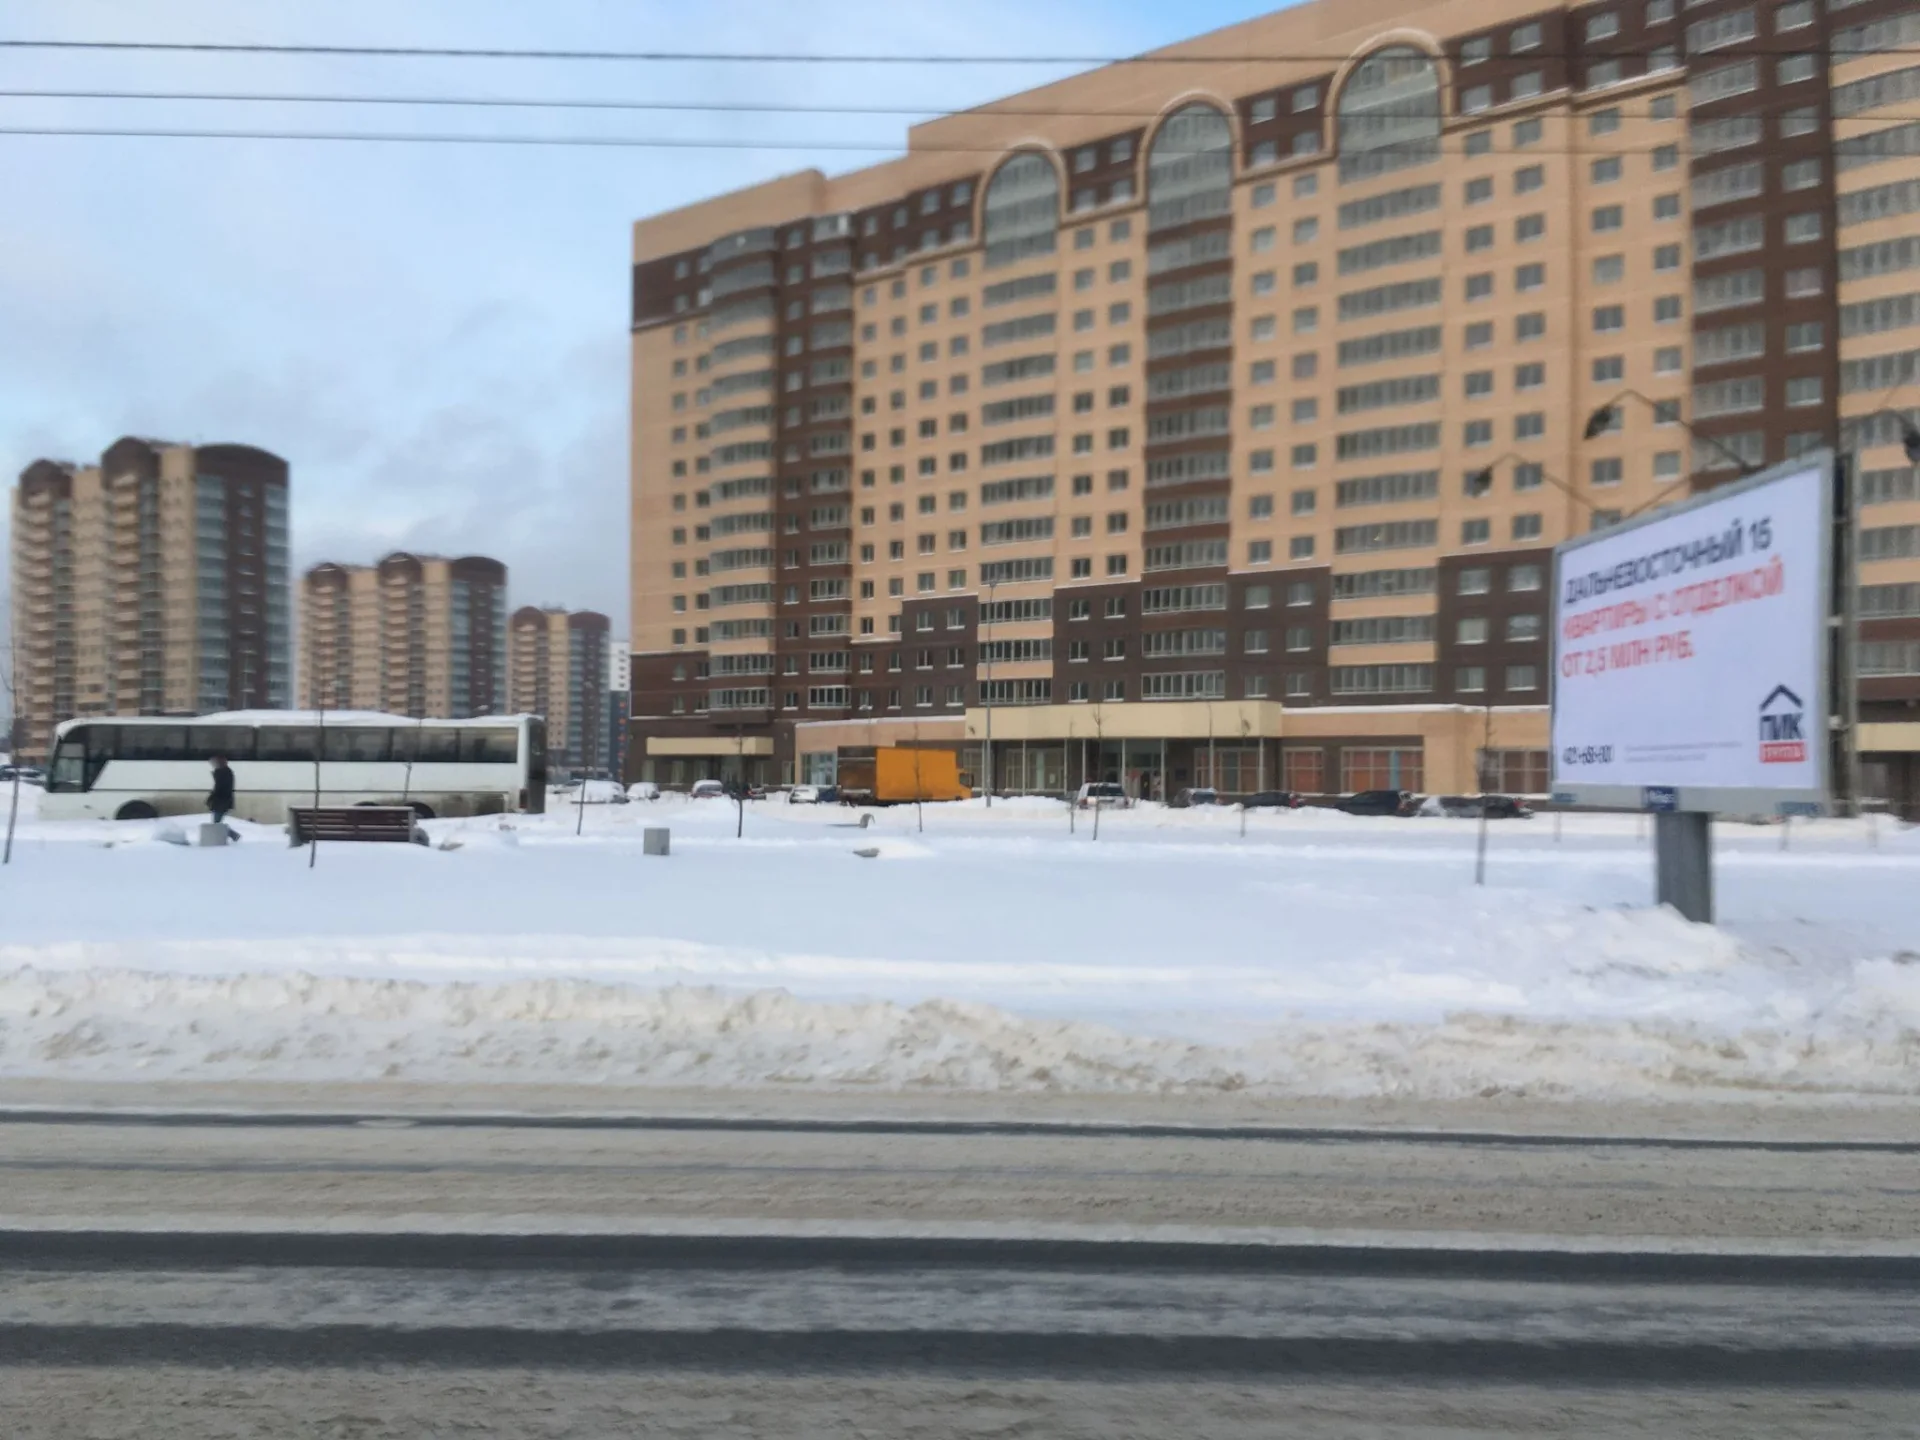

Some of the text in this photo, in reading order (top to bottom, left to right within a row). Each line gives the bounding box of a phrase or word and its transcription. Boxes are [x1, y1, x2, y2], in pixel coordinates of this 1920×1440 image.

[1565, 515, 1773, 604] ДАЛЬНЕВОСТОЧНЫЙ 15
[1564, 554, 1784, 640] КВАРТИРЫ С ОТДЕЛКОЙ
[1562, 652, 1584, 678] ОТ
[1610, 639, 1650, 669] МЛН
[1760, 712, 1803, 741] ПИК
